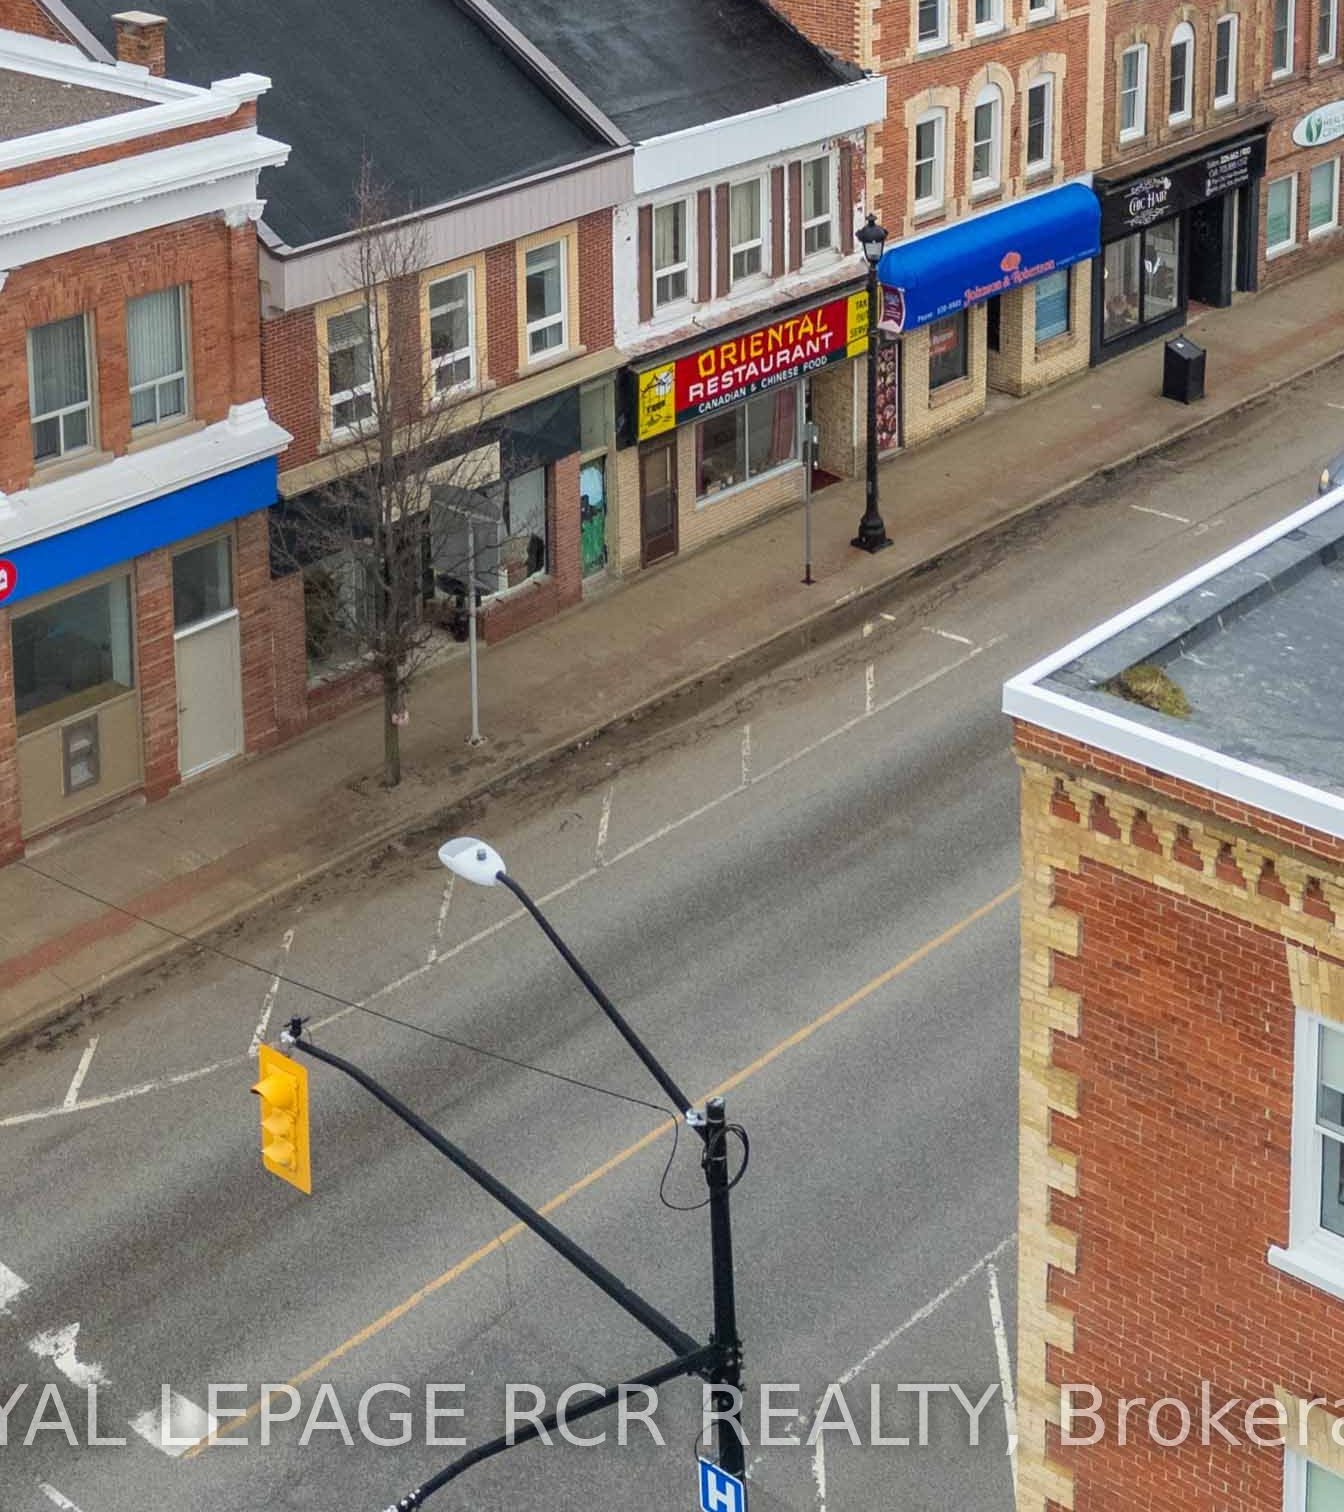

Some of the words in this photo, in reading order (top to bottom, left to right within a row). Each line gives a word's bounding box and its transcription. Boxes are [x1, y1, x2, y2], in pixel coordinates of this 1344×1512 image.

[963, 280, 1003, 308] Johnson
[1011, 259, 1056, 284] Robertson
[688, 332, 834, 402] RESTAURANT
[698, 310, 829, 378] ORIENTAL
[698, 388, 747, 414] CANADIAN
[750, 381, 757, 393] &
[760, 366, 799, 389] CHINESE
[803, 355, 828, 373] FOOD
[708, 1470, 736, 1512] H
